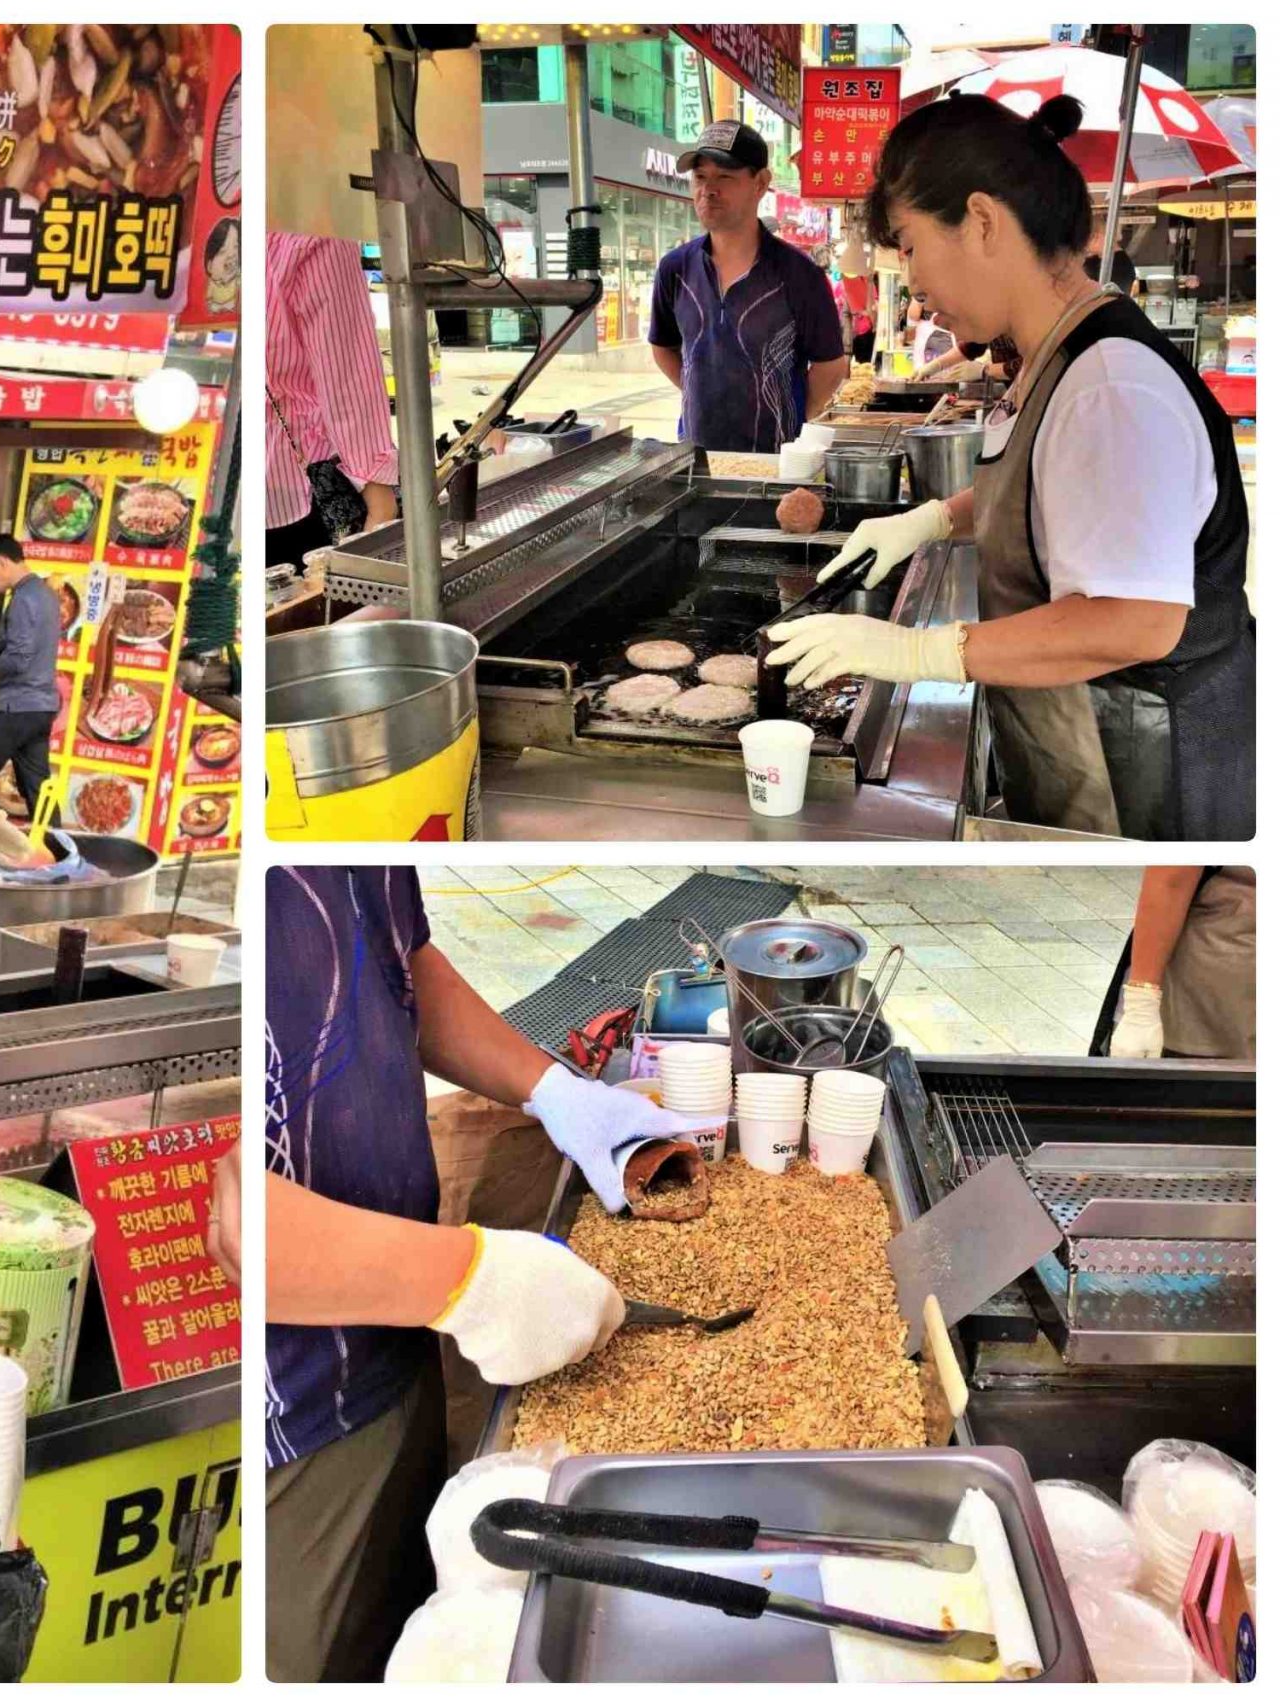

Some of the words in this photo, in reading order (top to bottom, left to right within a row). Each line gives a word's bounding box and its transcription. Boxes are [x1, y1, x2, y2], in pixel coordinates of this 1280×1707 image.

[821, 79, 884, 100] 원조집
[108, 1170, 157, 1202] 깨끗한
[160, 1160, 209, 1191] 기름에
[117, 1198, 196, 1239] 전자렌지에
[127, 1233, 206, 1273] 후라이팬에
[136, 1276, 183, 1308] 씨앗은
[148, 1356, 203, 1382] There
[210, 1345, 239, 1366] are
[94, 1462, 241, 1577] BU
